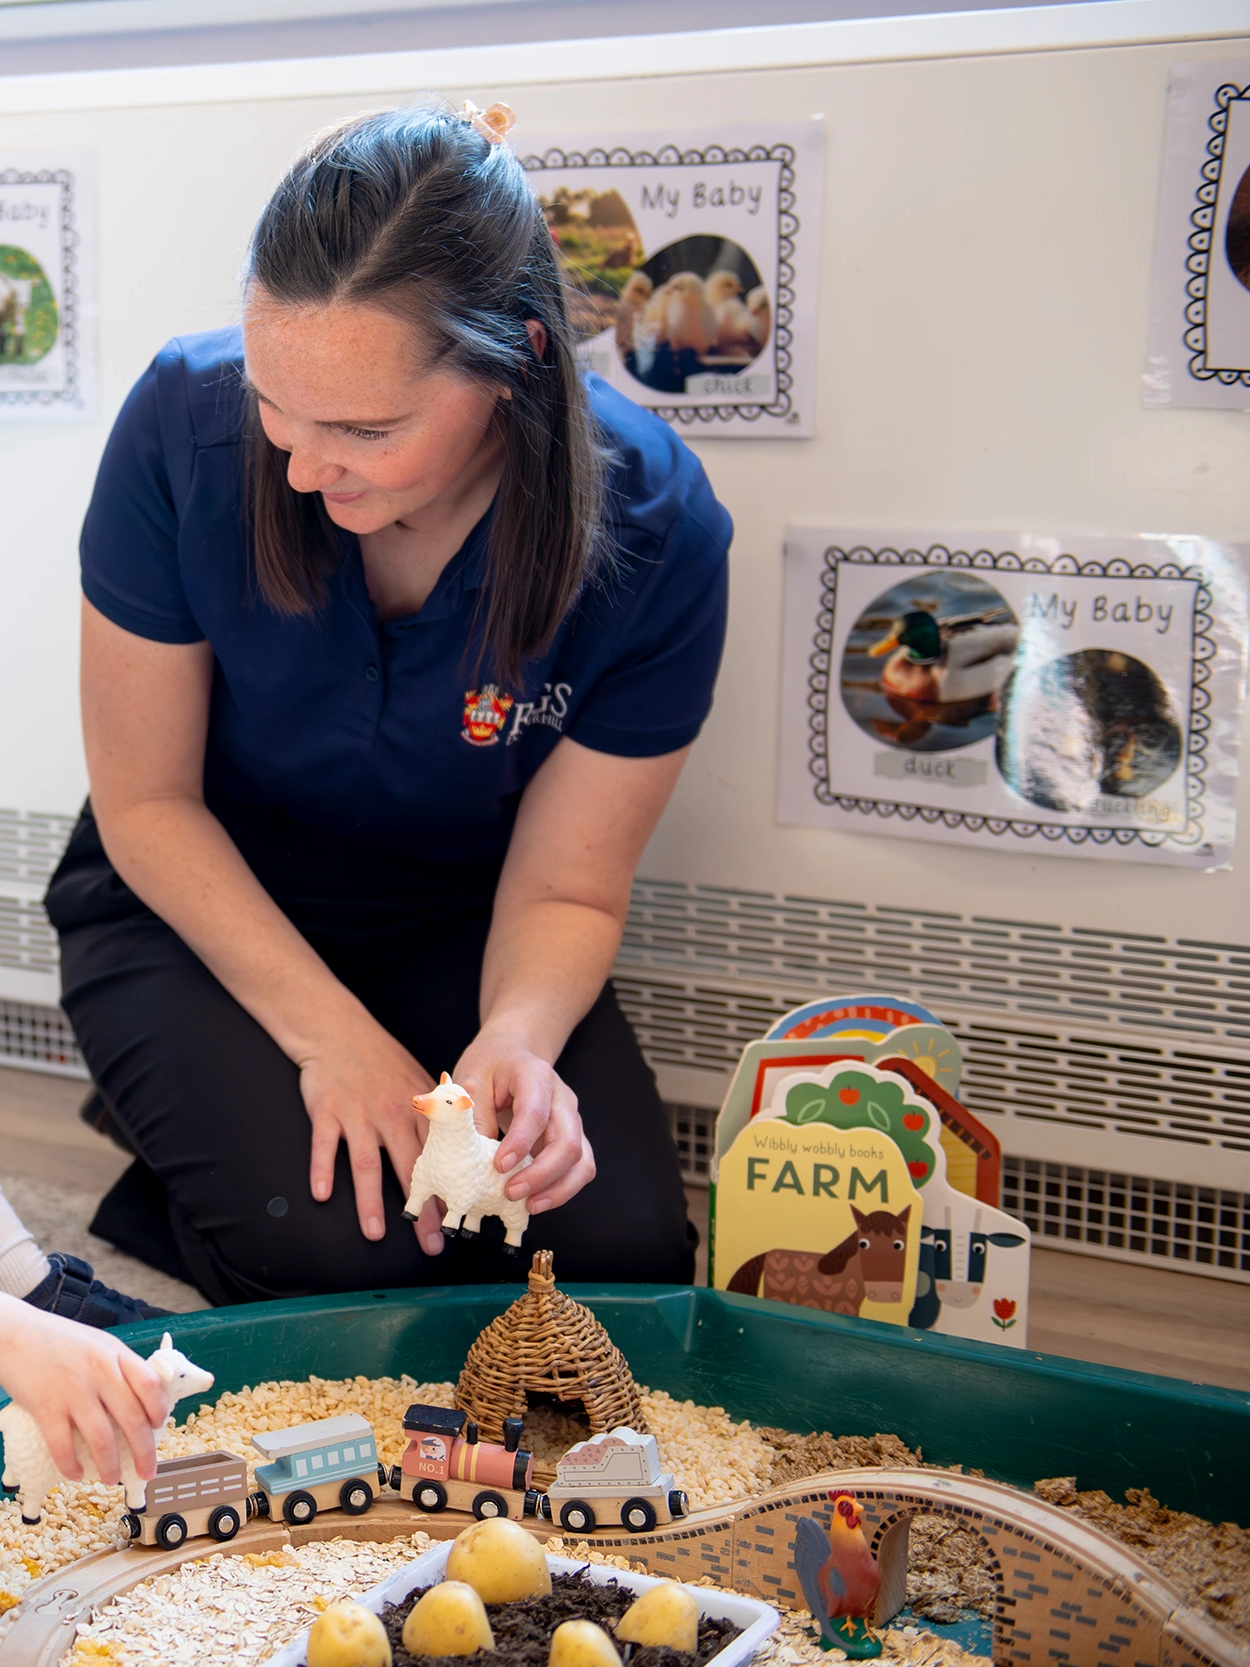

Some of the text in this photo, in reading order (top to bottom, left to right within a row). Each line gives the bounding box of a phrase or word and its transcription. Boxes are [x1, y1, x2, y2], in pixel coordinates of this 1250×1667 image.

[640, 180, 763, 218] My Baby
[1031, 592, 1174, 635] My Baby
[904, 752, 958, 780] duck
[754, 1134, 885, 1160] Wibbly wobbly books
[747, 1157, 889, 1204] FARM
[418, 1462, 445, 1475] NO.1
